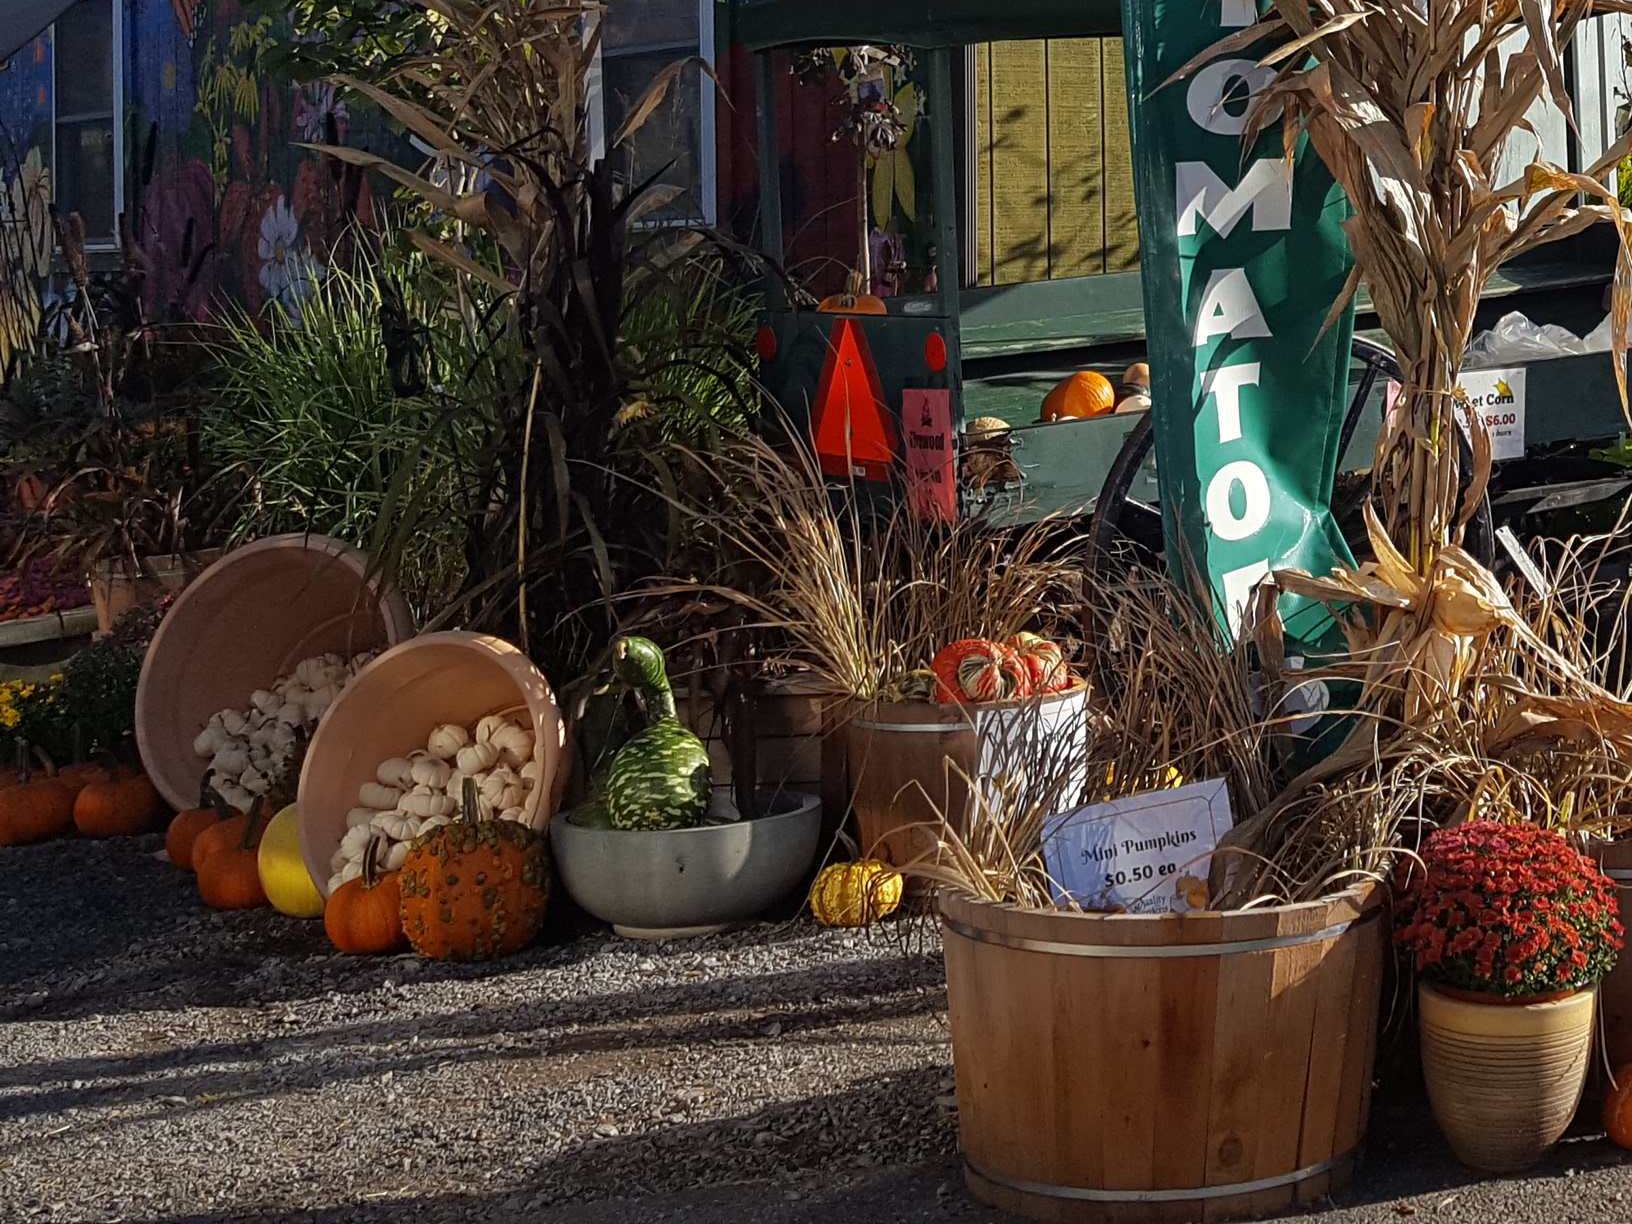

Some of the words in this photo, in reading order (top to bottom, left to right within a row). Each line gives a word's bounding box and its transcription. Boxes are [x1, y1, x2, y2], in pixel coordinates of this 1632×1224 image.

[1486, 392, 1515, 407] Corn
[1081, 843, 1119, 866] Mini
[1121, 829, 1198, 855] Pumpkins
[1104, 865, 1154, 888] $0.50
